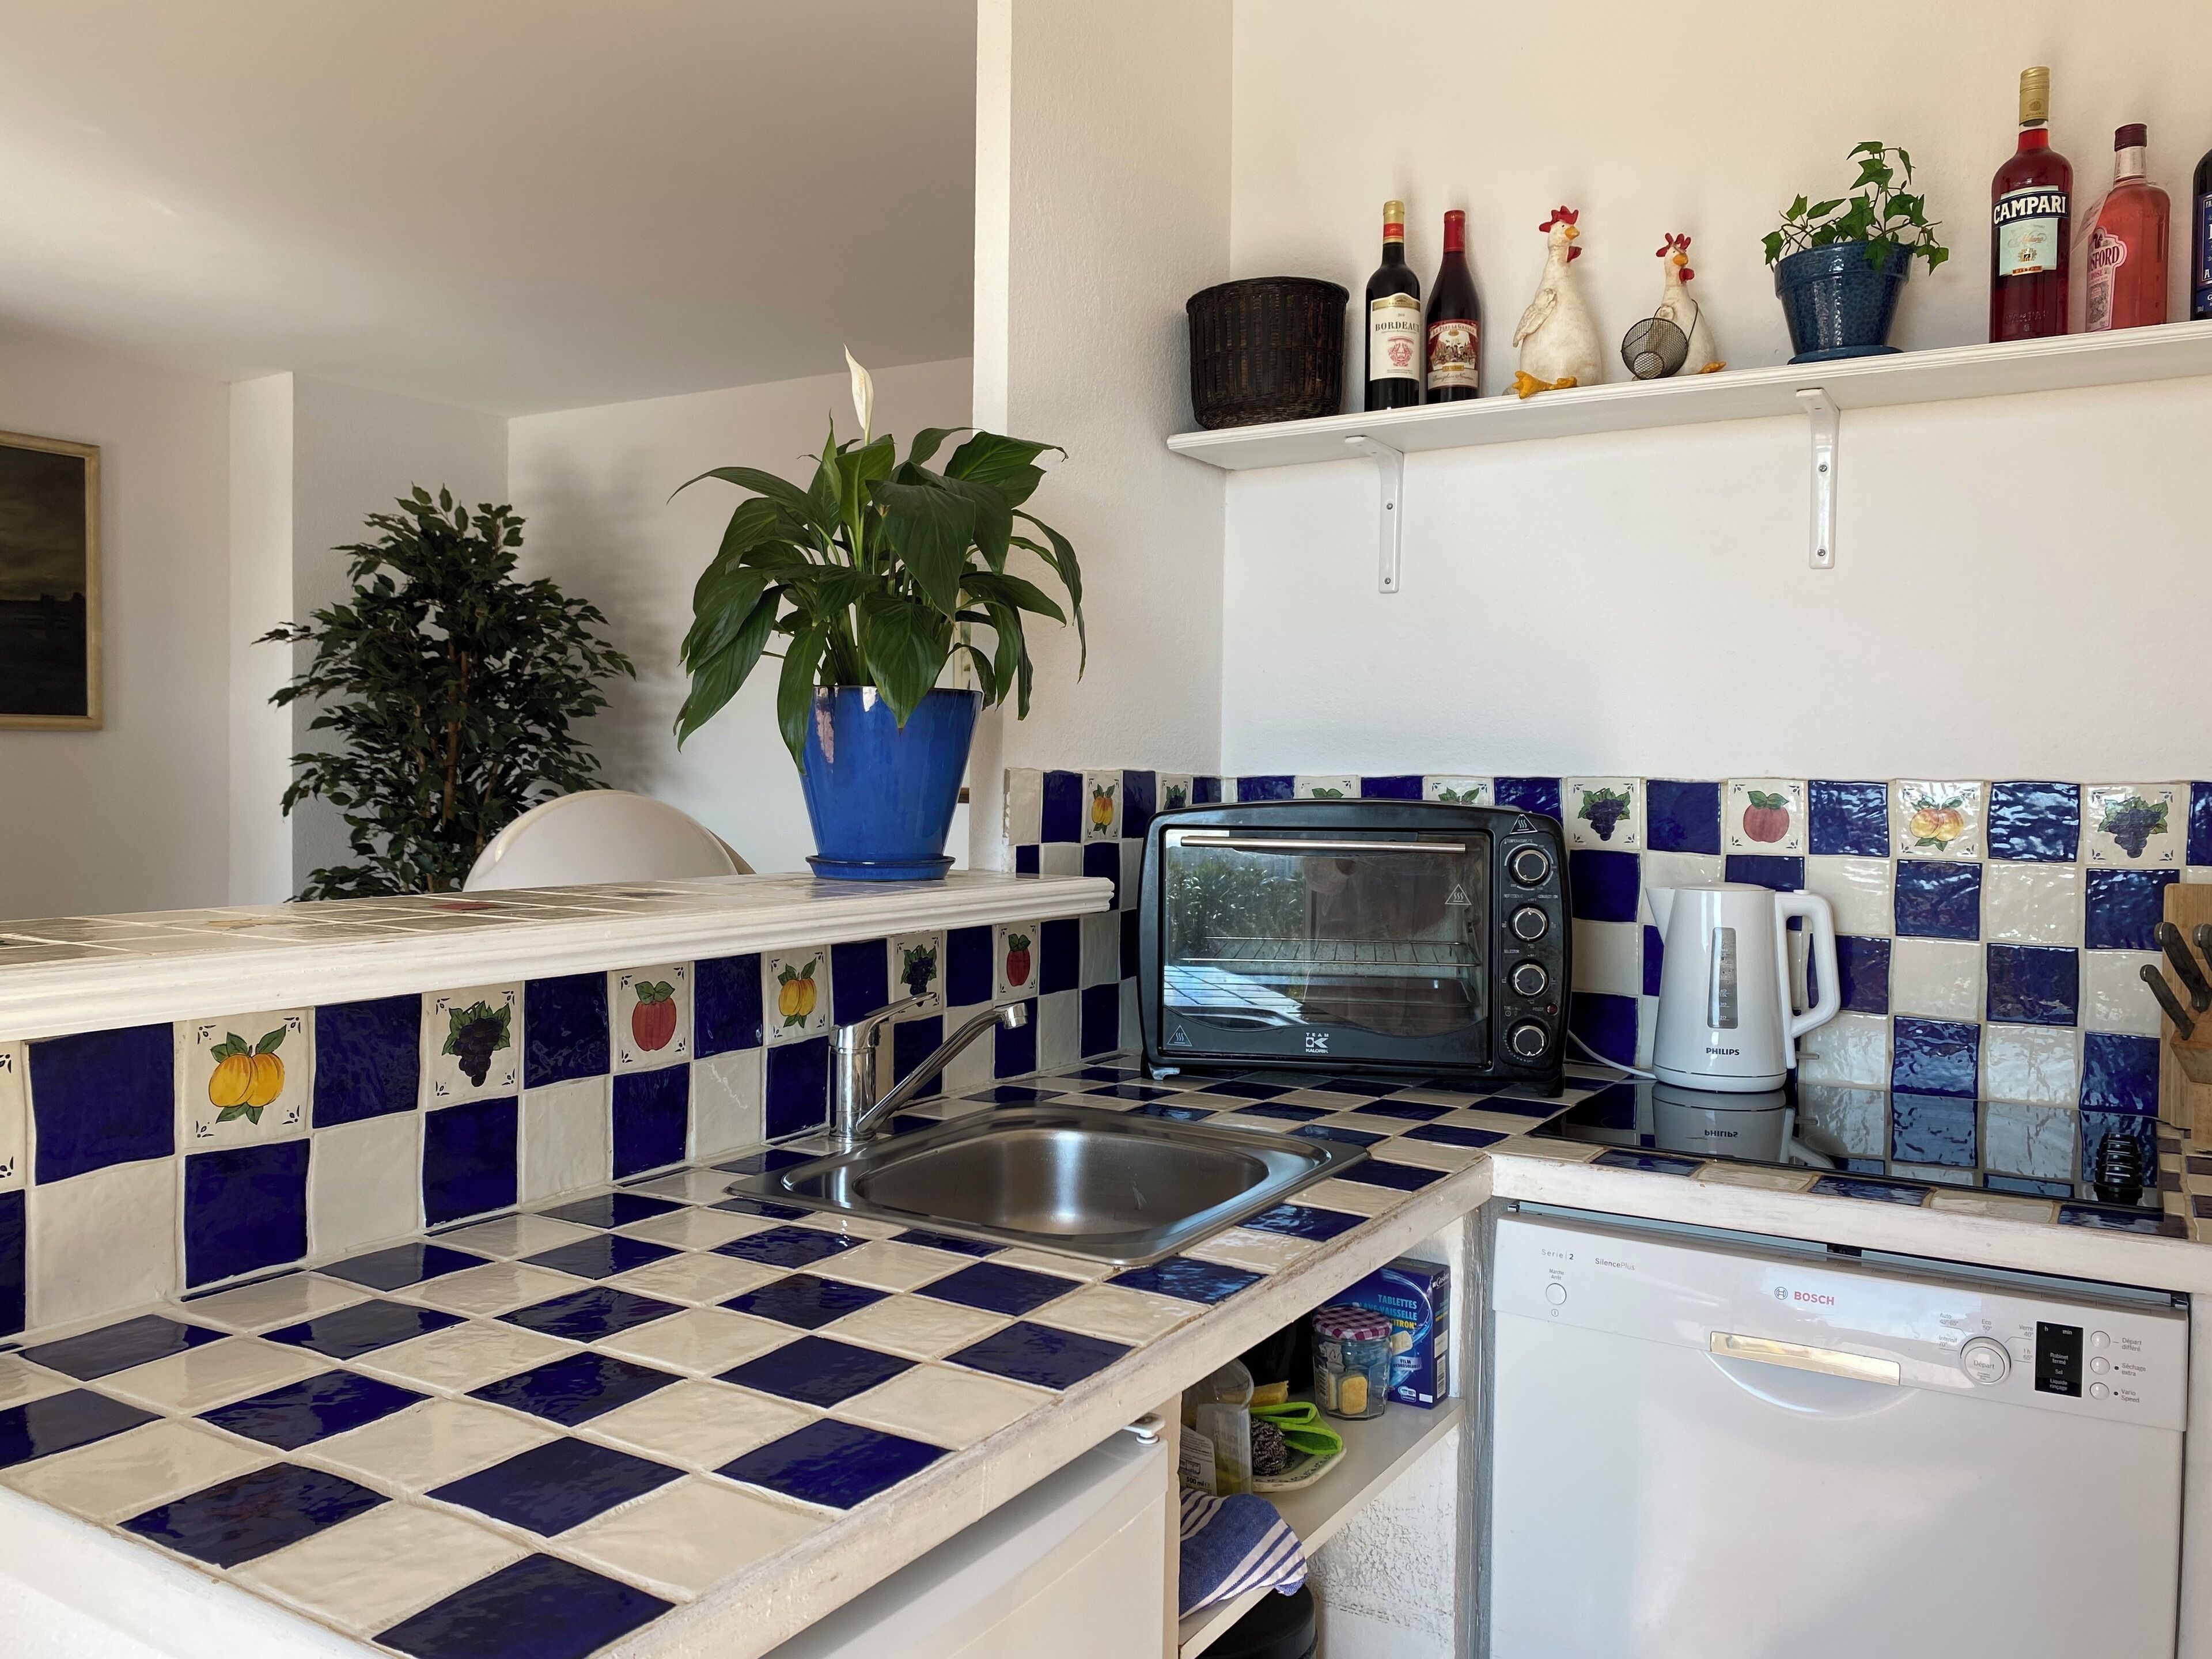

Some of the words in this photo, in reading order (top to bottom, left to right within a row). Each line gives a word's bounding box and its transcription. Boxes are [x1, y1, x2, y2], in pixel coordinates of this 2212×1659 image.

[1994, 195, 2067, 224] CAMPARI
[2089, 246, 2120, 271] SFORD
[1706, 1047, 1740, 1056] PHILIPS
[1541, 1248, 1564, 1259] Serie
[1594, 1257, 1635, 1271] SilencePlus
[1378, 1294, 1417, 1309] TABLETTES
[1794, 1291, 1835, 1306] BOSCH
[1939, 1335, 1958, 1343] Intensif
[2122, 1337, 2142, 1346] Départ
[2050, 1352, 2069, 1360] Robinet
[1974, 1359, 1995, 1369] Départ
[2122, 1362, 2146, 1372] Séchage
[2050, 1378, 2068, 1386] Liquide
[2121, 1388, 2136, 1396] Vario
[2121, 1395, 2140, 1403] Speed
[1187, 1476, 1197, 1484] 500
